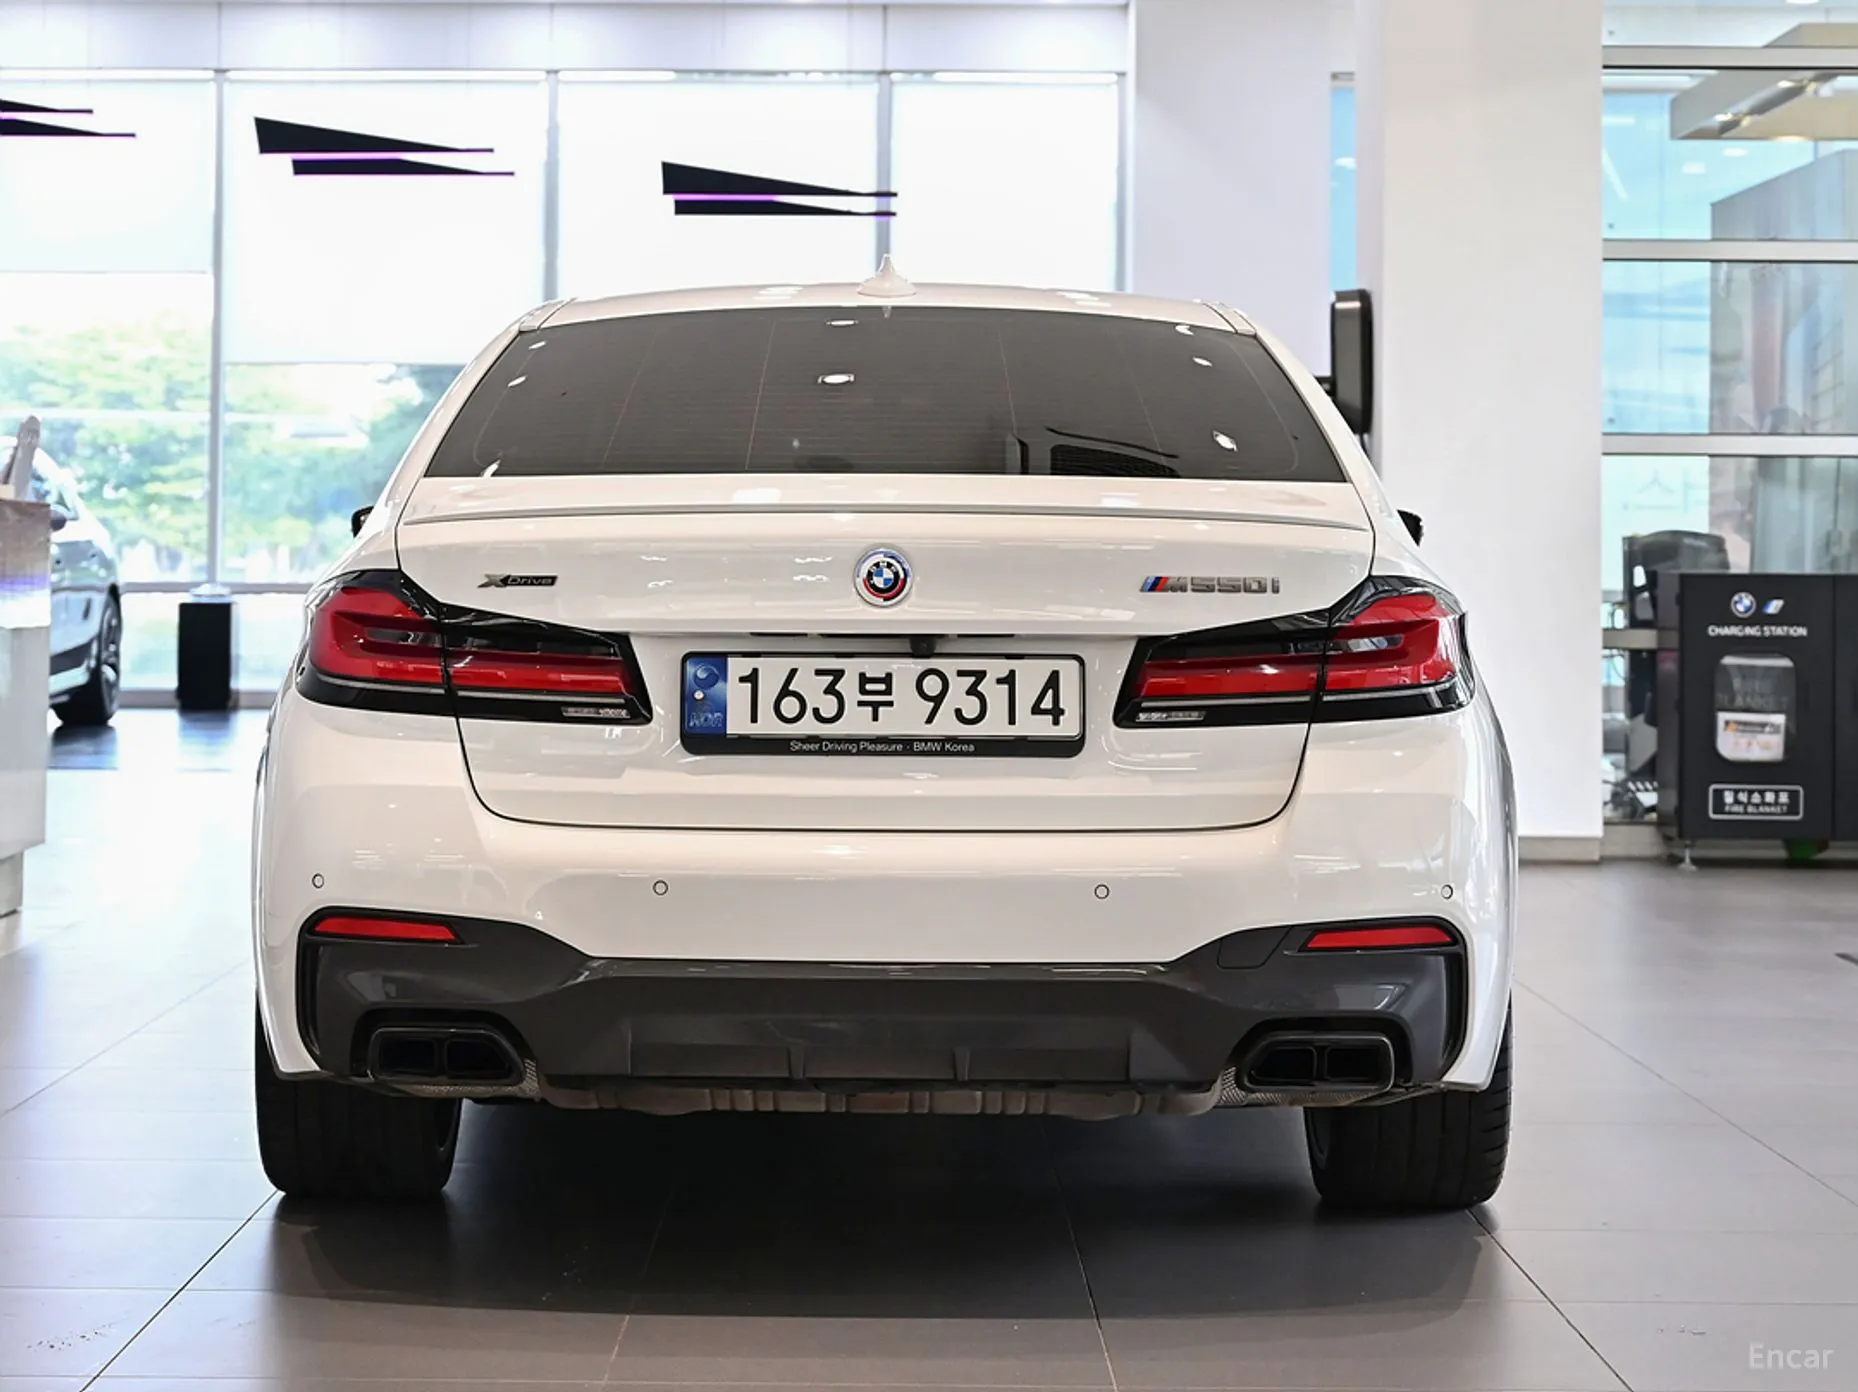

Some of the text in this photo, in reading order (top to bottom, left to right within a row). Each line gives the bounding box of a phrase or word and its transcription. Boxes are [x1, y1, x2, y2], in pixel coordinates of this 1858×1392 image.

[1707, 624, 1808, 637] CHARGING STATION
[737, 667, 1066, 726] 163부 9314
[790, 741, 976, 753] Sheer Driving Pleasure BMW Korea
[1724, 805, 1788, 814] FIRE BLANKET
